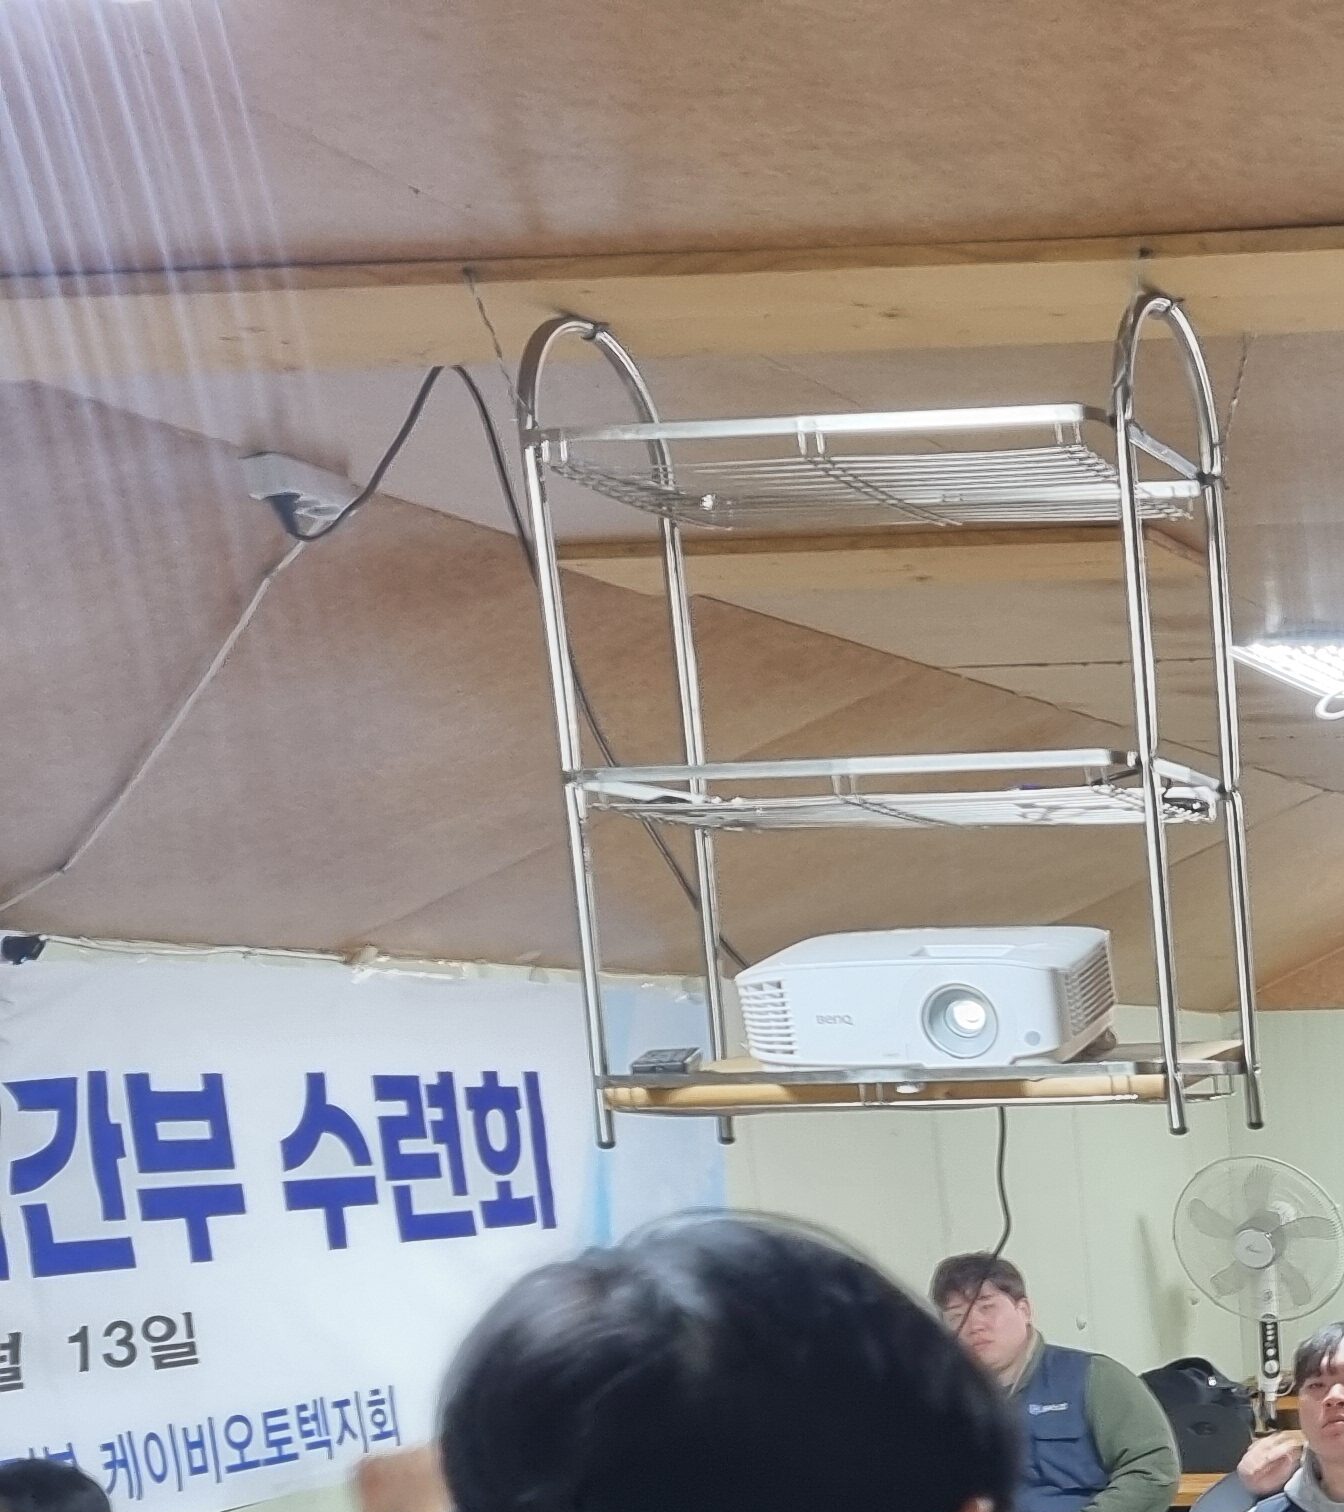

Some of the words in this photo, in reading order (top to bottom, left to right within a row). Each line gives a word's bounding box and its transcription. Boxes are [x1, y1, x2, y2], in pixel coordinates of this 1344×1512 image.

[0, 1070, 247, 1281] 간부
[280, 1070, 557, 1250] 수련회
[68, 1311, 200, 1373] 13일
[100, 1384, 402, 1501] 케이비오토텍지회
